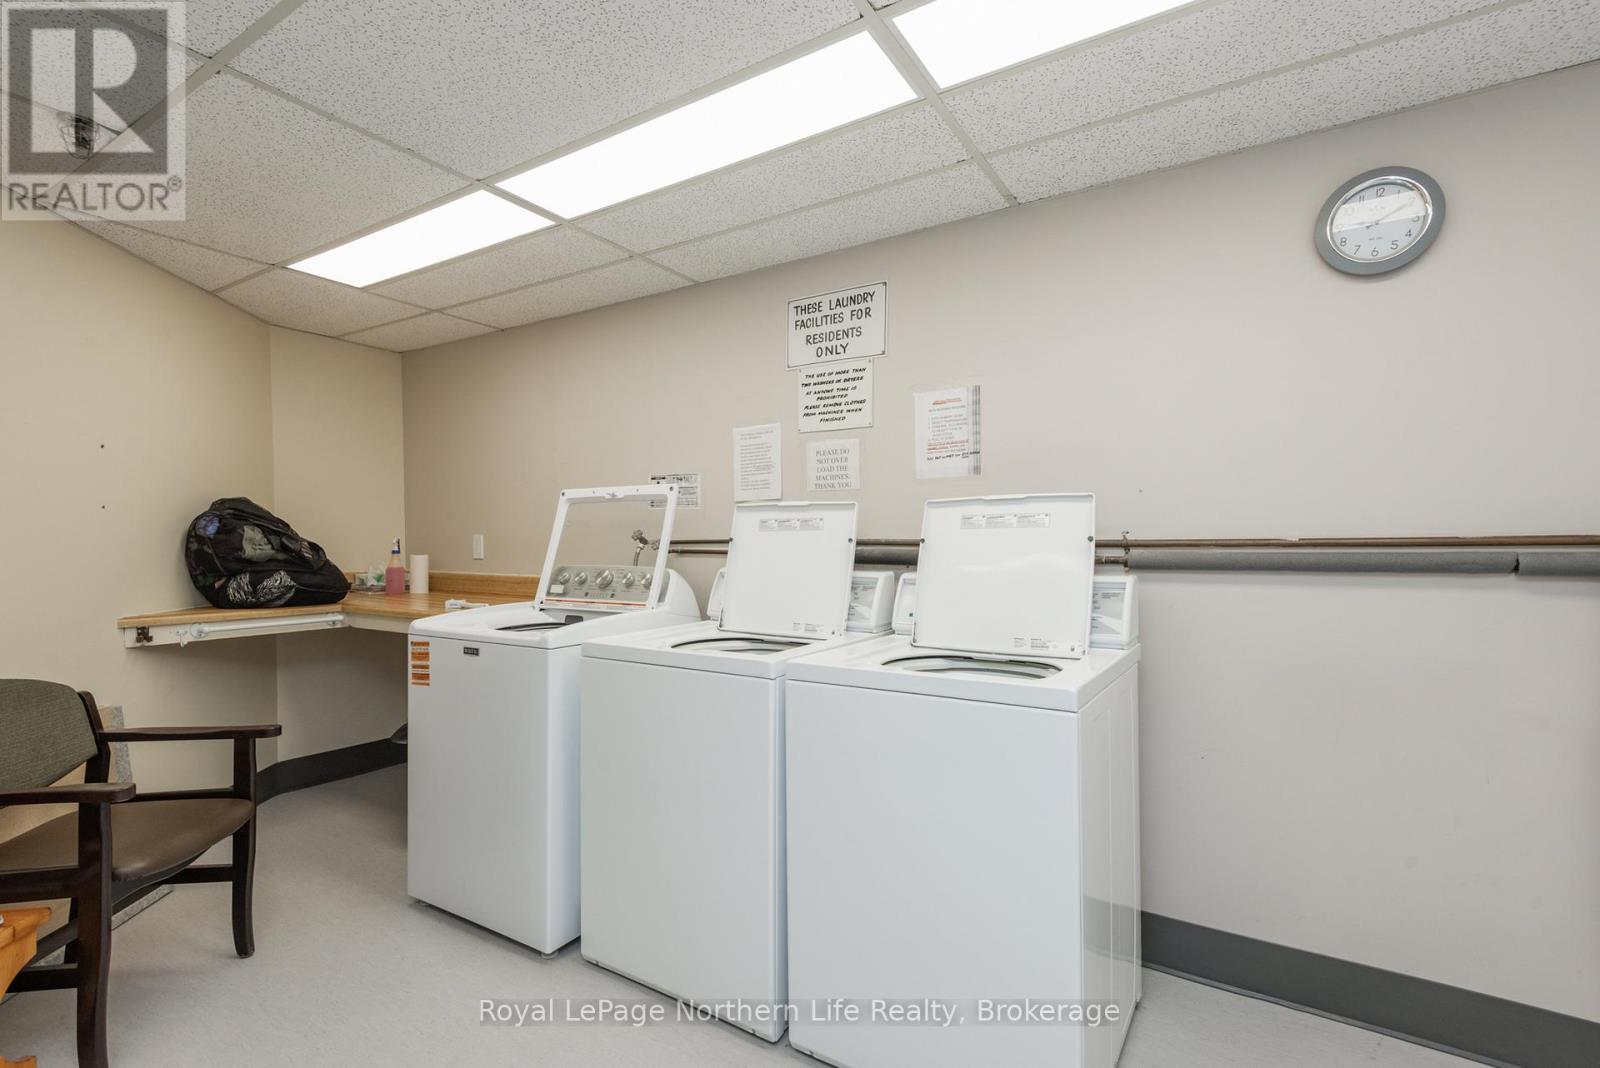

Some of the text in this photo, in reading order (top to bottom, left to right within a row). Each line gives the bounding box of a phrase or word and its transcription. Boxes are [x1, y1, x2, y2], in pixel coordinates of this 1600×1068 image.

[1376, 188, 1386, 198] 12
[1404, 229, 1412, 238] 4
[1340, 238, 1347, 247] 8
[1390, 240, 1399, 250] 5
[1354, 245, 1361, 255] 7
[1371, 247, 1379, 256] 6
[794, 291, 876, 316] THESE LAUNDRY
[795, 307, 872, 330] FACILITIES FOR
[806, 326, 862, 345] RESIDENTS
[816, 342, 849, 358] ONLY
[815, 449, 838, 457] PLEASE
[838, 481, 852, 489] YOU
